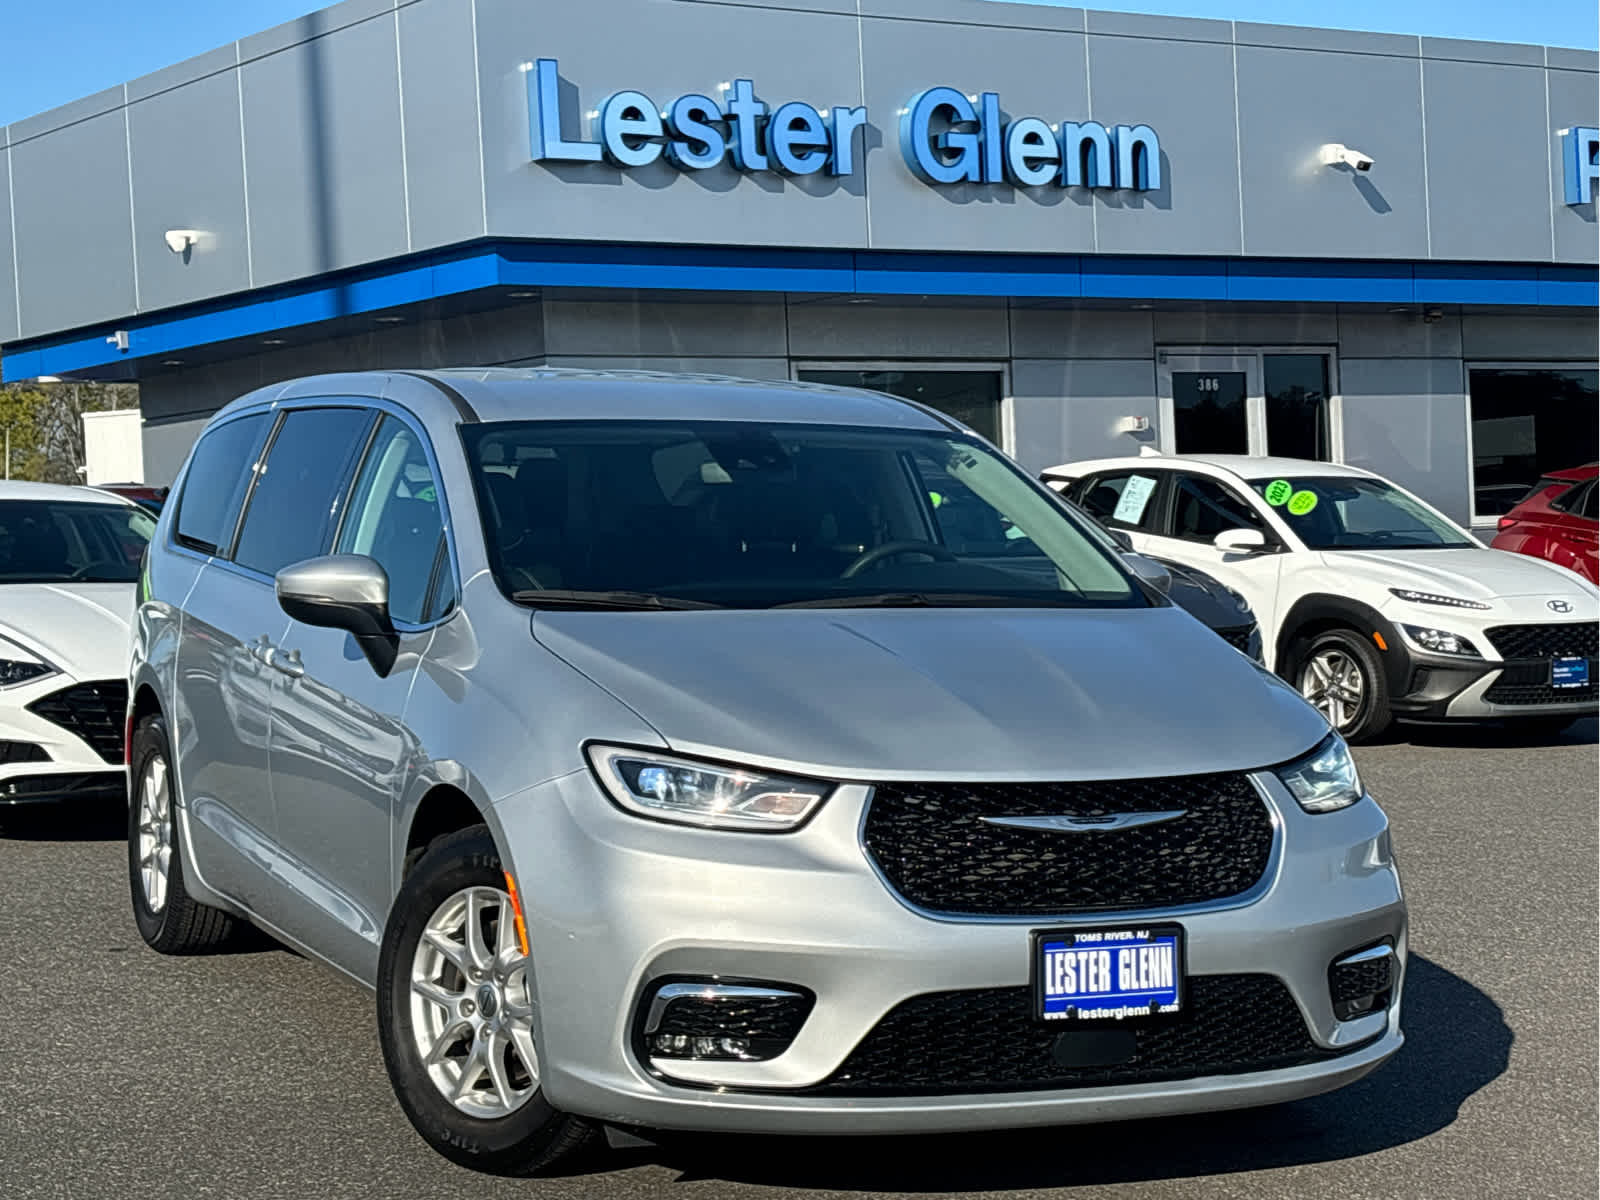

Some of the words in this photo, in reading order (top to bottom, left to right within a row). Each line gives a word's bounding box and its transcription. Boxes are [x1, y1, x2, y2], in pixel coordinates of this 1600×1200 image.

[530, 58, 866, 177] Lester
[901, 86, 1161, 190] Glenn
[1198, 378, 1219, 391] 386
[1269, 481, 1288, 503] 2023
[1074, 932, 1103, 943] TOMS
[1136, 929, 1150, 939] NJ
[1045, 950, 1111, 995] LESTER
[1118, 946, 1174, 991] GLENN
